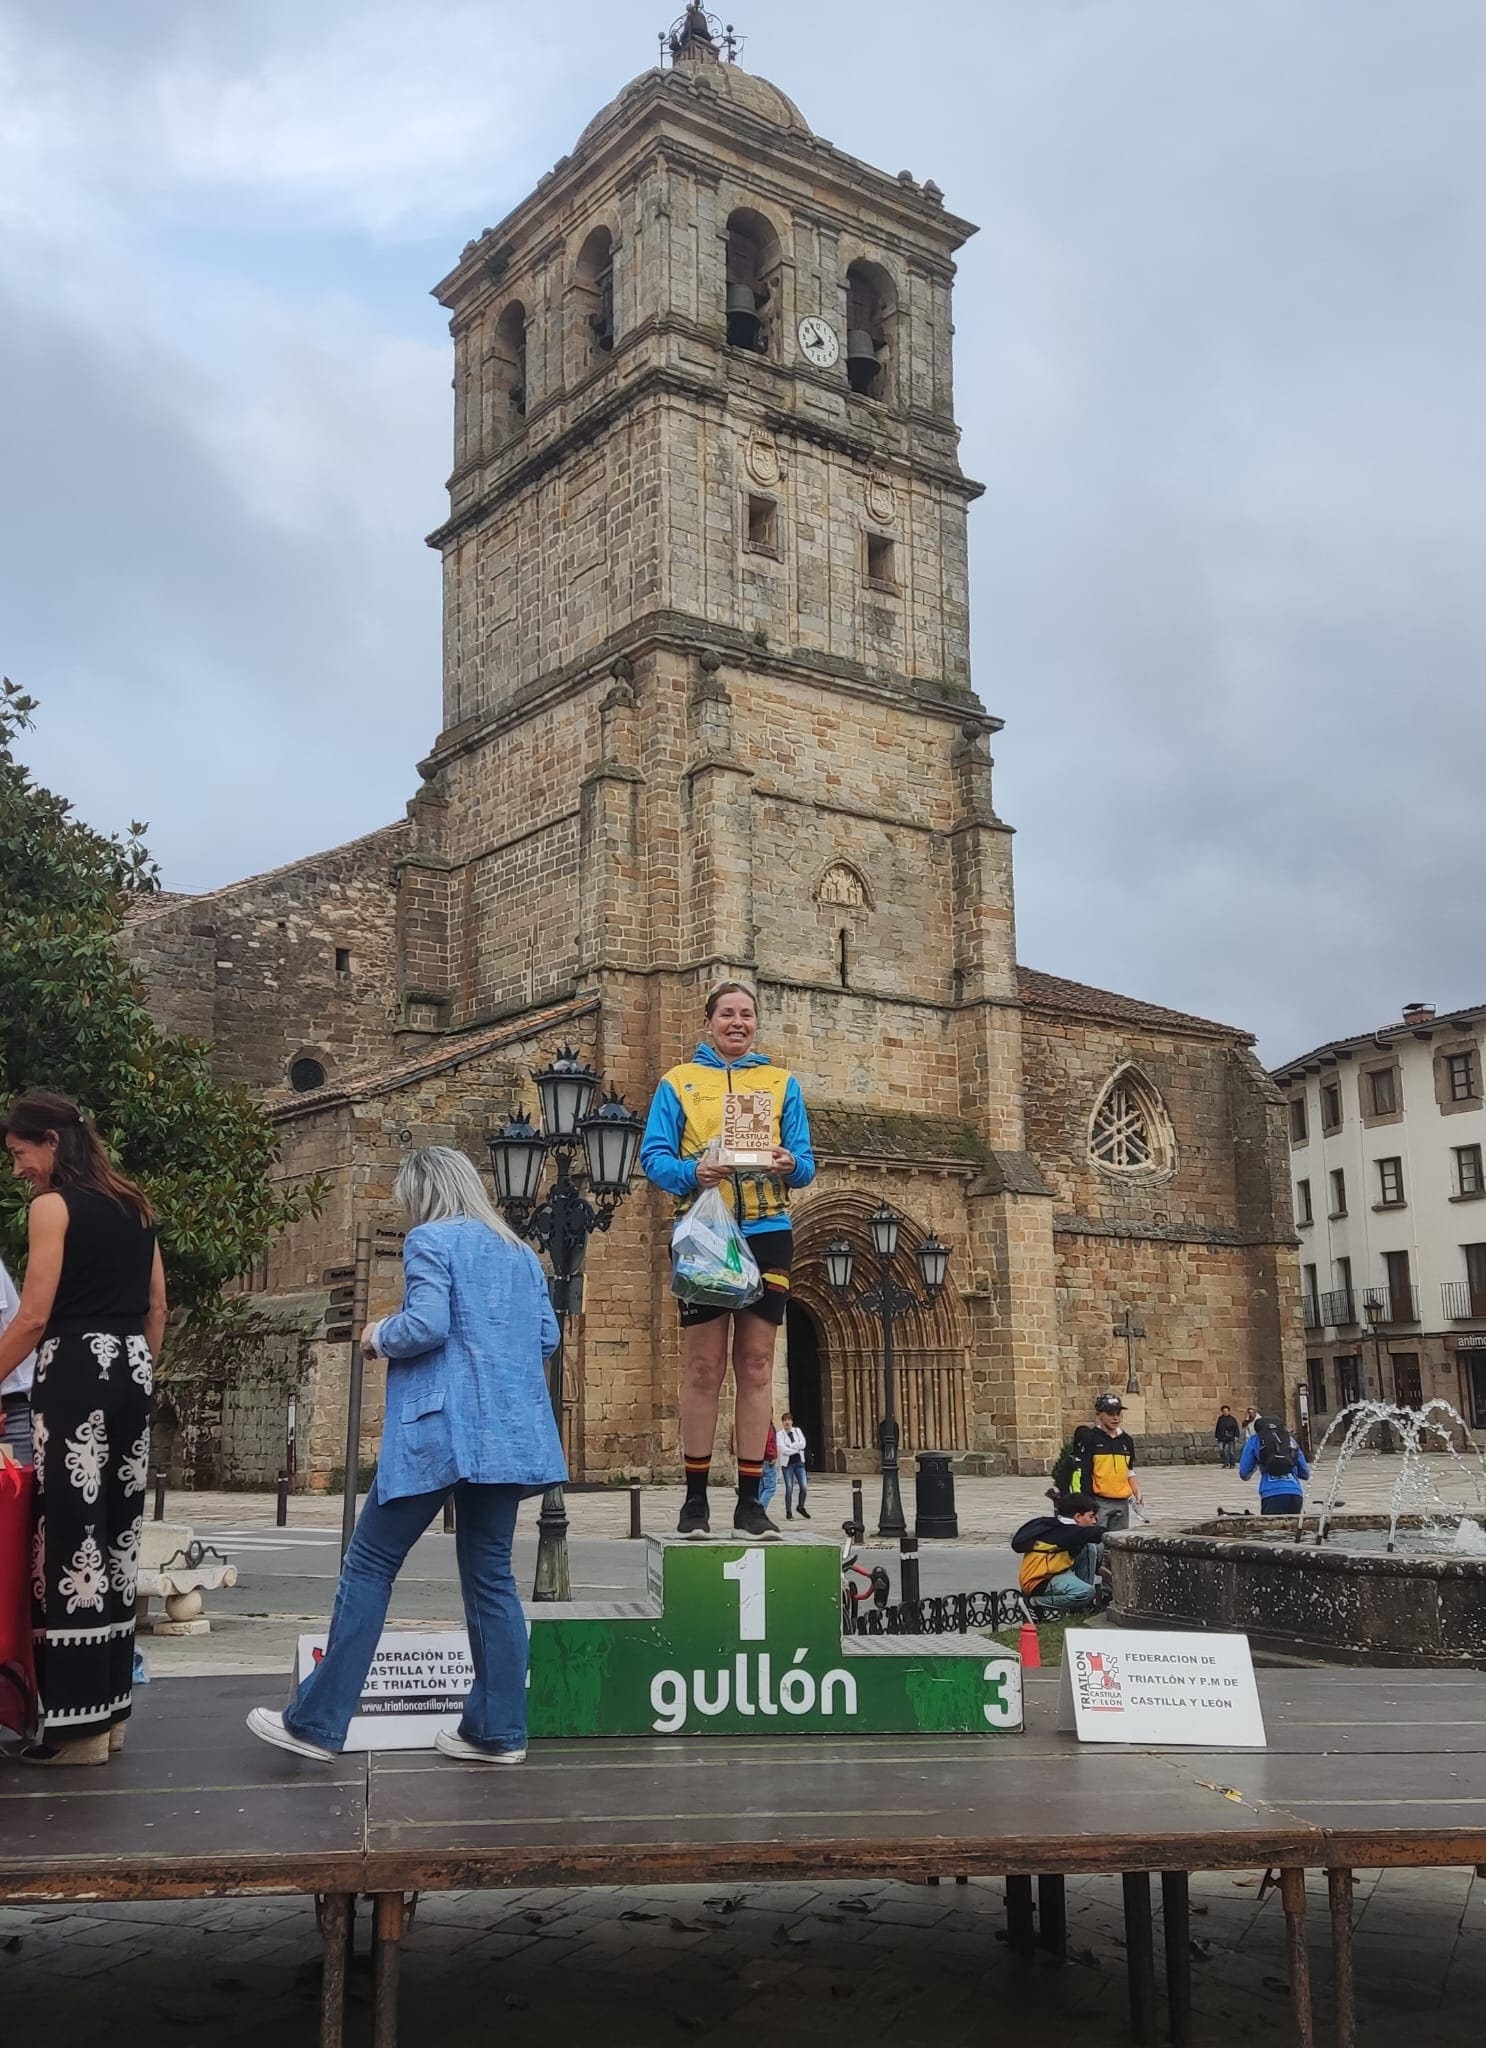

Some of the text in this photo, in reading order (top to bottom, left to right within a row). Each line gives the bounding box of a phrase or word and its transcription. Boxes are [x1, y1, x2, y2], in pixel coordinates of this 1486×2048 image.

[725, 1094, 736, 1147] RIATLON
[724, 1548, 766, 1641] 1
[371, 1649, 464, 1662] DERACIÓN DE
[1125, 1653, 1217, 1665] FEDERACION DE
[369, 1662, 473, 1677] ASTILLA Y LEÓN
[383, 1676, 446, 1690] TRIATLÓN
[451, 1679, 459, 1689] Y
[1075, 1650, 1092, 1711] TRIATLON
[1128, 1674, 1239, 1687] TRIATLÓN Y P.M DE
[650, 1648, 858, 1733] gullón
[983, 1659, 1022, 1728] 3
[1090, 1690, 1122, 1699] CASTILLA
[1131, 1696, 1188, 1707] CASTILLA
[1190, 1698, 1199, 1708] Y
